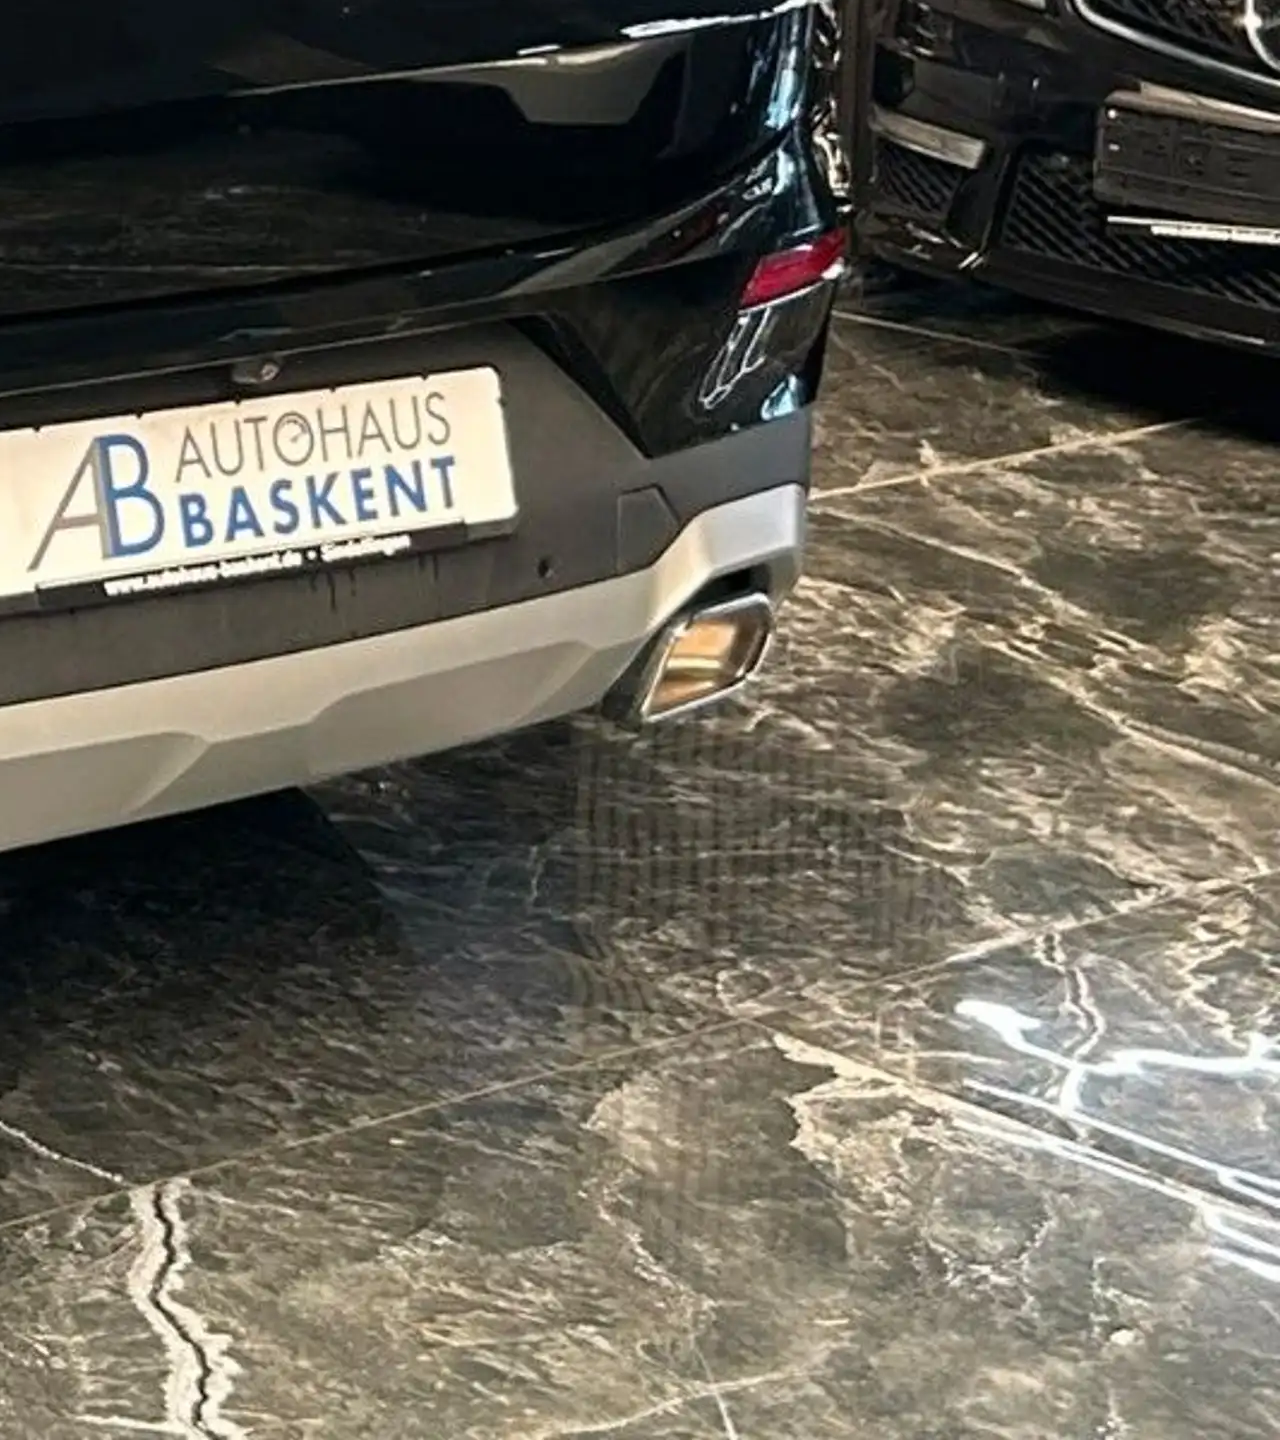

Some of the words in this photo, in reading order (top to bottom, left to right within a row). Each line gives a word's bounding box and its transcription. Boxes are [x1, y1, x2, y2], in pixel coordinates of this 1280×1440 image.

[175, 392, 451, 483] AUTOHAUS
[26, 433, 165, 572] AB
[178, 456, 456, 548] BASKENT
